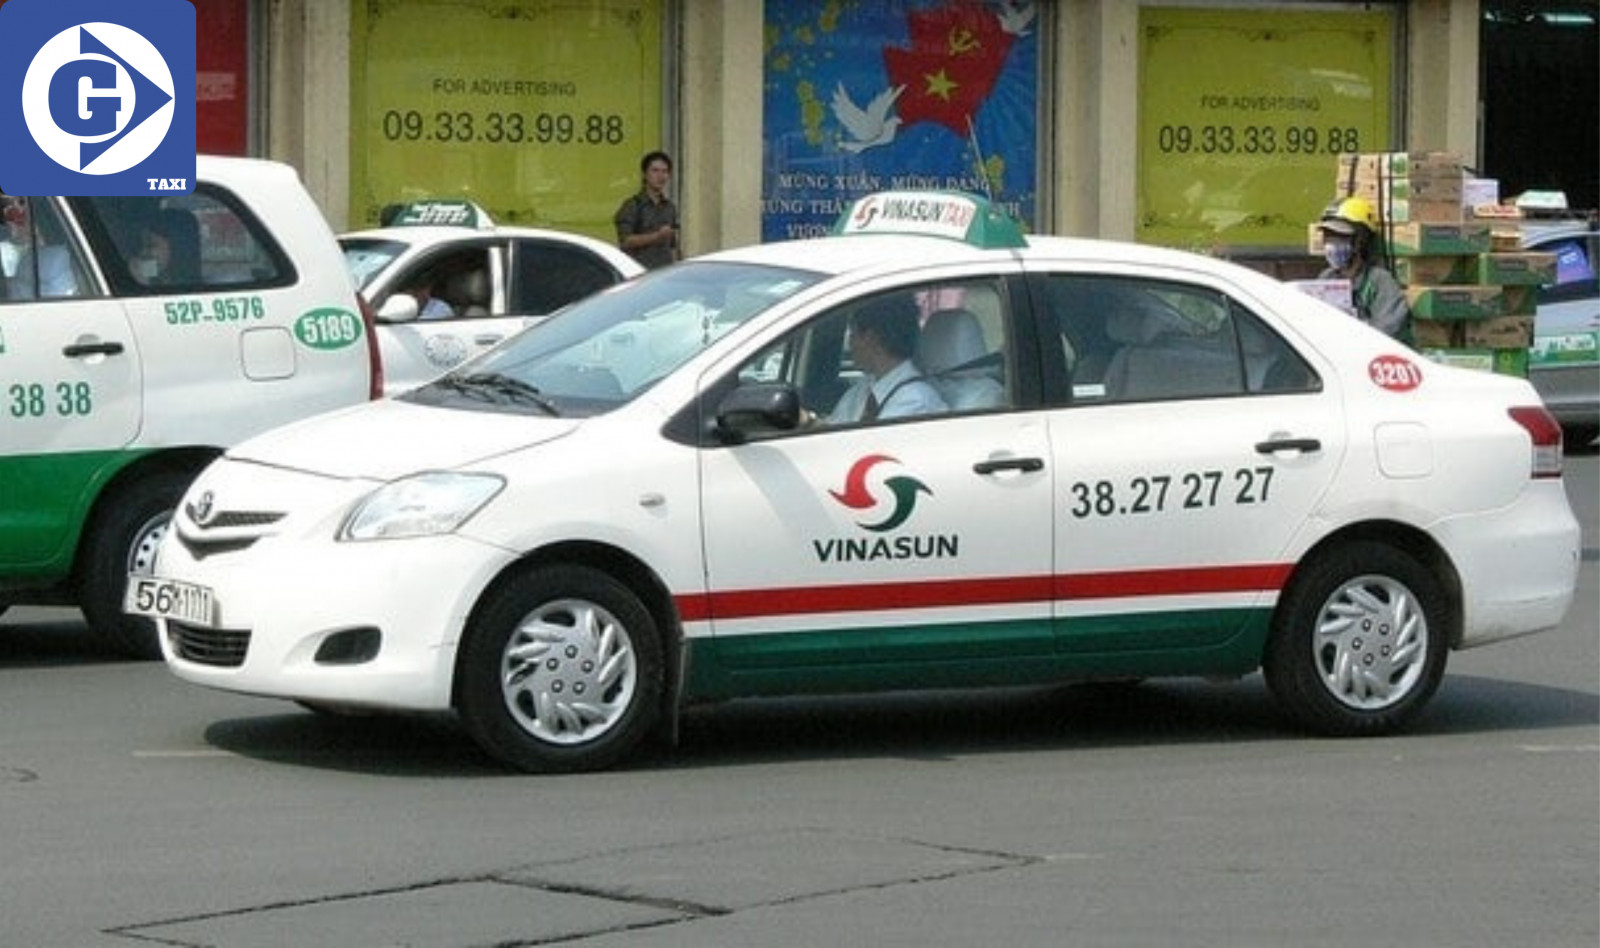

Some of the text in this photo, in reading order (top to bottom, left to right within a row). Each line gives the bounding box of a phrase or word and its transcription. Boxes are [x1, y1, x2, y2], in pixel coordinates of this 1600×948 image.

[432, 78, 576, 97] FOR ADVERTISING
[1201, 95, 1321, 112] FOR ADVERTISING
[383, 110, 624, 145] 09.33.33.99.88
[1159, 125, 1359, 154] 09.33.33.99.88
[303, 315, 356, 343] 5189
[9, 381, 92, 418] 38 38
[1071, 466, 1274, 519] 38.27 27 27
[813, 534, 959, 562] VINASUN
